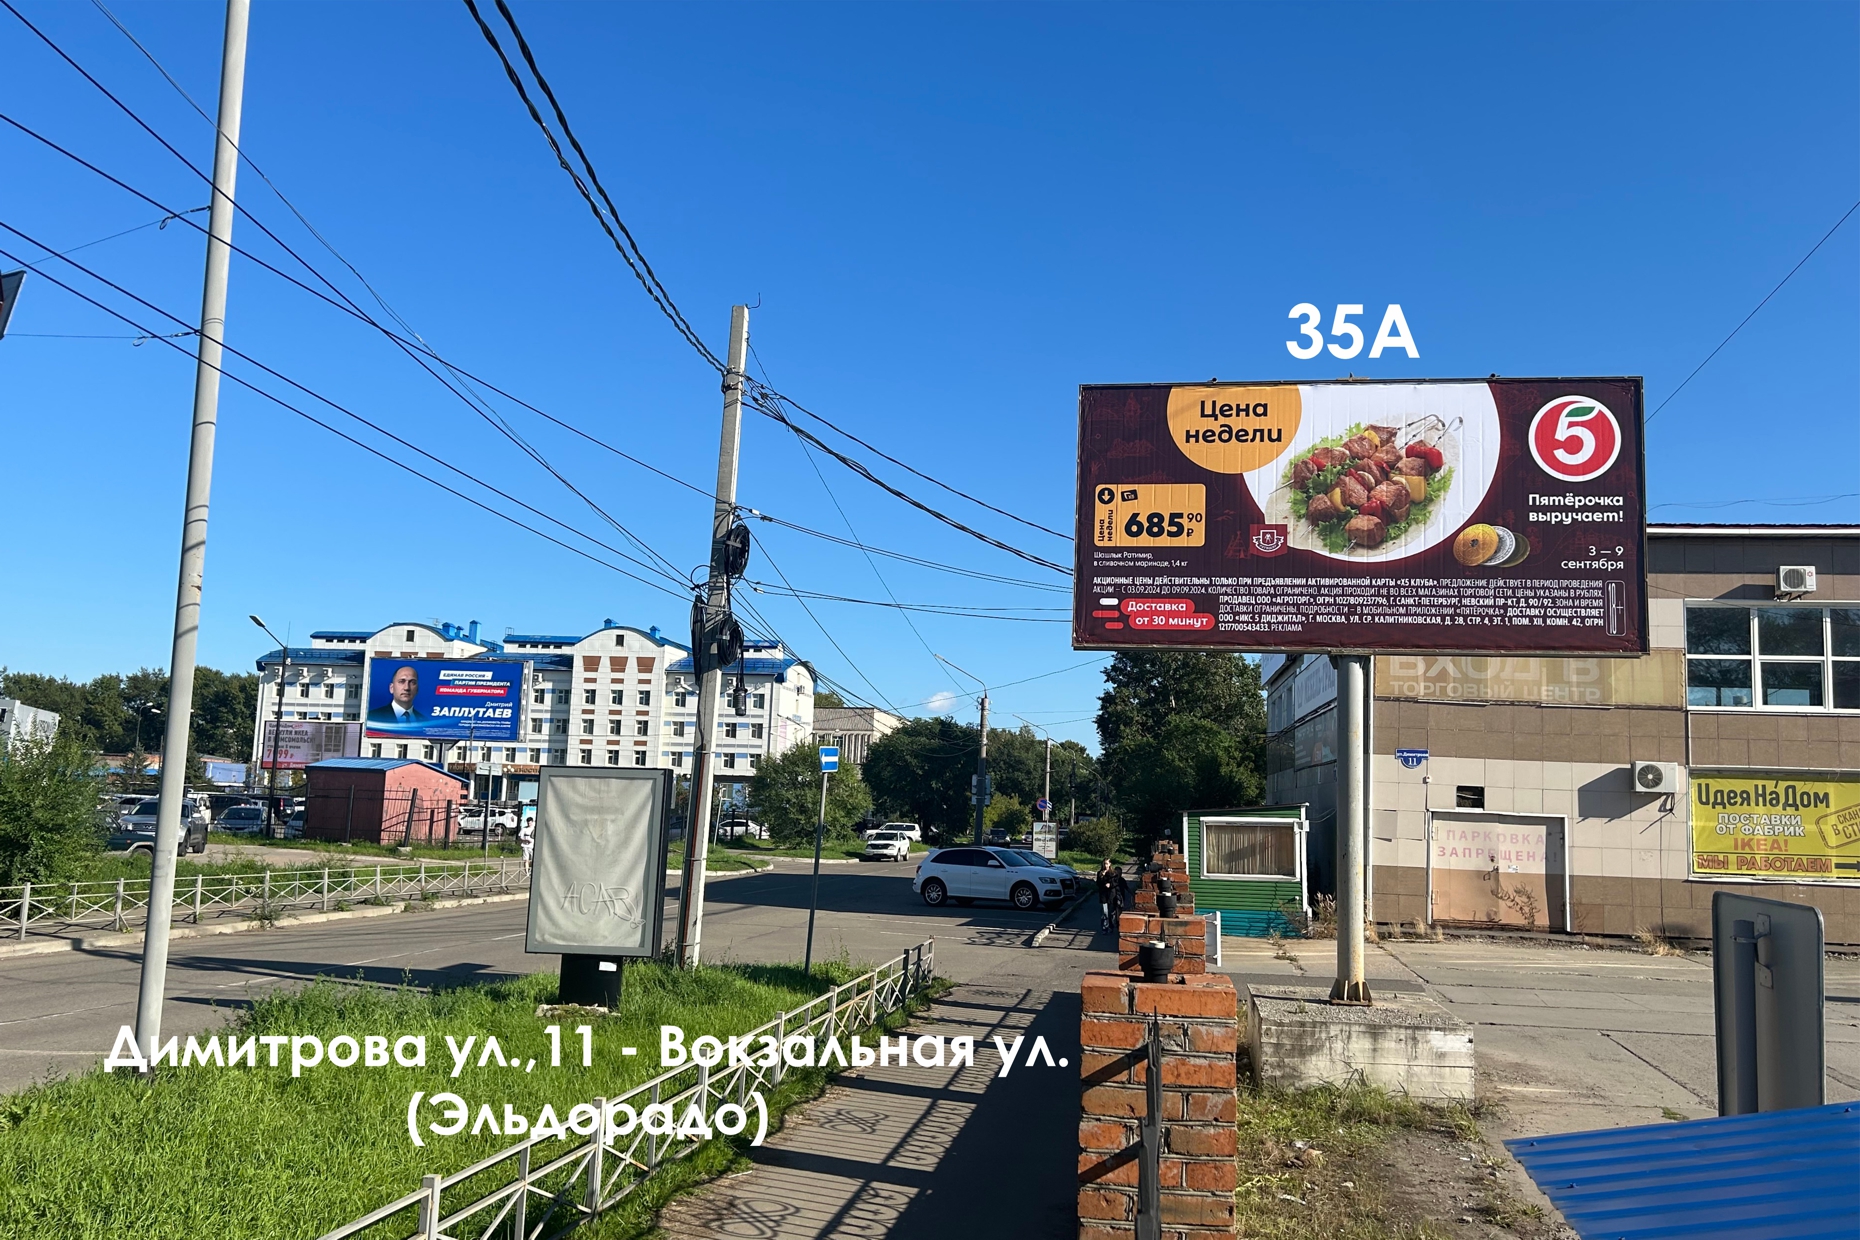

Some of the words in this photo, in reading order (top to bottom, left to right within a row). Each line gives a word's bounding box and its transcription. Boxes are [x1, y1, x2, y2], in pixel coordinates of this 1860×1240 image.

[1200, 400, 1268, 421] Цена
[1185, 423, 1282, 444] недели
[1528, 493, 1624, 508] Пятёрочка
[1528, 510, 1624, 524] выручает!
[1097, 518, 1105, 542] Цена
[1105, 509, 1114, 542] недели
[1124, 512, 1185, 539] 685
[1186, 512, 1203, 523] 90
[1093, 551, 1122, 559] Шашлык
[1123, 551, 1153, 560] Ратимир,
[1588, 546, 1597, 556] 3
[1615, 546, 1624, 556] 9
[1135, 560, 1170, 568] маринаде,
[1560, 558, 1624, 571] сентября
[1092, 577, 1133, 585] АКЦИОННЫЕ
[1134, 577, 1153, 585] ЦЕНЫ
[1154, 576, 1210, 585] ДЕЙСТВИТЕЛЬНЫ
[1211, 577, 1237, 585] ТОЛЬКО
[1238, 577, 1252, 585] ПРИ
[1253, 577, 1306, 586] ПРЕДЪЯВЛЕНИИ
[1307, 577, 1371, 586] АКТИВИРОВАННОЙ
[1372, 578, 1395, 586] КАРТЫ
[1411, 578, 1439, 587] КЛУБА».
[1440, 579, 1488, 587] ПРЕДЛОЖЕНИЕ
[1489, 578, 1526, 588] ДЕЙСТВУЕТ
[1526, 580, 1532, 588] В
[1532, 579, 1559, 588] ПЕРИОД
[1559, 579, 1603, 588] ПРОВЕДЕНИЯ
[1092, 586, 1115, 594] АКЦИИ
[1121, 586, 1126, 594] С
[1127, 586, 1160, 594] 03.09.2024
[1161, 586, 1171, 594] ДО
[1171, 586, 1207, 594] 09.09.2024.
[1208, 586, 1249, 594] КОЛИЧЕСТВО
[1250, 586, 1275, 594] ТОВАРА
[1275, 586, 1319, 595] ОГРАНИЧЕНО.
[1320, 587, 1342, 595] АКЦИЯ
[1343, 587, 1379, 596] ПРОХОДИТ
[1380, 588, 1388, 596] НЕ
[1389, 588, 1399, 596] ВО
[1400, 588, 1417, 596] ВСЕХ
[1418, 588, 1458, 596] МАГАЗИНАХ
[1460, 587, 1494, 596] ТОРГОВОЙ
[1495, 589, 1515, 597] СЕТИ.
[1515, 589, 1535, 598] ЦЕНЫ
[1536, 589, 1569, 597] УКАЗАНЫ
[1570, 589, 1575, 597] В
[1576, 589, 1604, 598] РУБЛЯХ.
[1127, 601, 1187, 612] Доставка
[1219, 596, 1256, 605] ПРОДАВЕЦ
[1256, 596, 1271, 604] ООО
[1272, 596, 1315, 605] «АГРОТОРГ»,
[1316, 596, 1334, 604] ОГРН
[1396, 597, 1461, 606] САНКТ-ПЕТЕРБУРГ,
[1461, 596, 1494, 606] НЕВСКИЙ
[1495, 598, 1519, 607] ПР-КТ,
[1555, 599, 1573, 607] ЗОНА
[1574, 599, 1580, 607] И
[1580, 599, 1603, 607] ВРЕМЯ
[1219, 605, 1252, 613] ДОСТАВКИ
[1253, 605, 1299, 613] ОГРАНИЧЕНЫ.
[1300, 605, 1348, 614] ПОДРОБНОСТИ
[1356, 606, 1362, 614] В
[1362, 606, 1407, 614] МОБИЛЬНОМ
[1408, 606, 1455, 615] ПРИЛОЖЕНИИ
[1506, 608, 1545, 616] ДОСТАВКУ
[1546, 608, 1604, 617] ОСУЩЕСТВЛЯЕТ
[1135, 617, 1149, 625] от
[1152, 616, 1165, 625] 30
[1168, 617, 1208, 628] минут
[1218, 614, 1234, 622] ООО
[1235, 614, 1253, 622] «ИКС
[1254, 614, 1260, 622] 5
[1260, 614, 1308, 624] ДИДЖИТАЛ»,
[1316, 615, 1347, 624] МОСКВА,
[1349, 615, 1361, 623] УЛ.
[1362, 615, 1373, 623] СР.
[1374, 616, 1443, 625] КАЛИТНИКОВСКАЯ,
[1444, 616, 1453, 625] Д.
[1454, 616, 1466, 625] 28,
[1467, 617, 1482, 625] СТР.
[1492, 617, 1503, 625] ЭТ.
[1512, 618, 1532, 626] ПОМ.
[1546, 618, 1570, 626] КОМН.
[1571, 618, 1583, 627] 42,
[1584, 618, 1604, 627] ОГРН
[1271, 624, 1303, 632] РЕКЛАМА
[1389, 680, 1515, 698] ТОРГОВЫЙ
[1522, 685, 1600, 701] ЦЕНТР
[431, 706, 512, 718] ЗАПЛУТАЕВ
[266, 749, 289, 758] 799
[1408, 757, 1417, 765] 11
[1717, 812, 1802, 825] ПОСТАВКИ
[1446, 829, 1545, 845] ПАРКОВКА
[1715, 824, 1737, 835] ОТ
[1741, 825, 1806, 837] ФАБРИК
[1733, 837, 1789, 852] IKEA!
[1437, 846, 1557, 863] ЗАПРЕЩЕНА!
[1697, 854, 1729, 870] МЫ
[1736, 856, 1833, 873] РАБОТАЕМ
